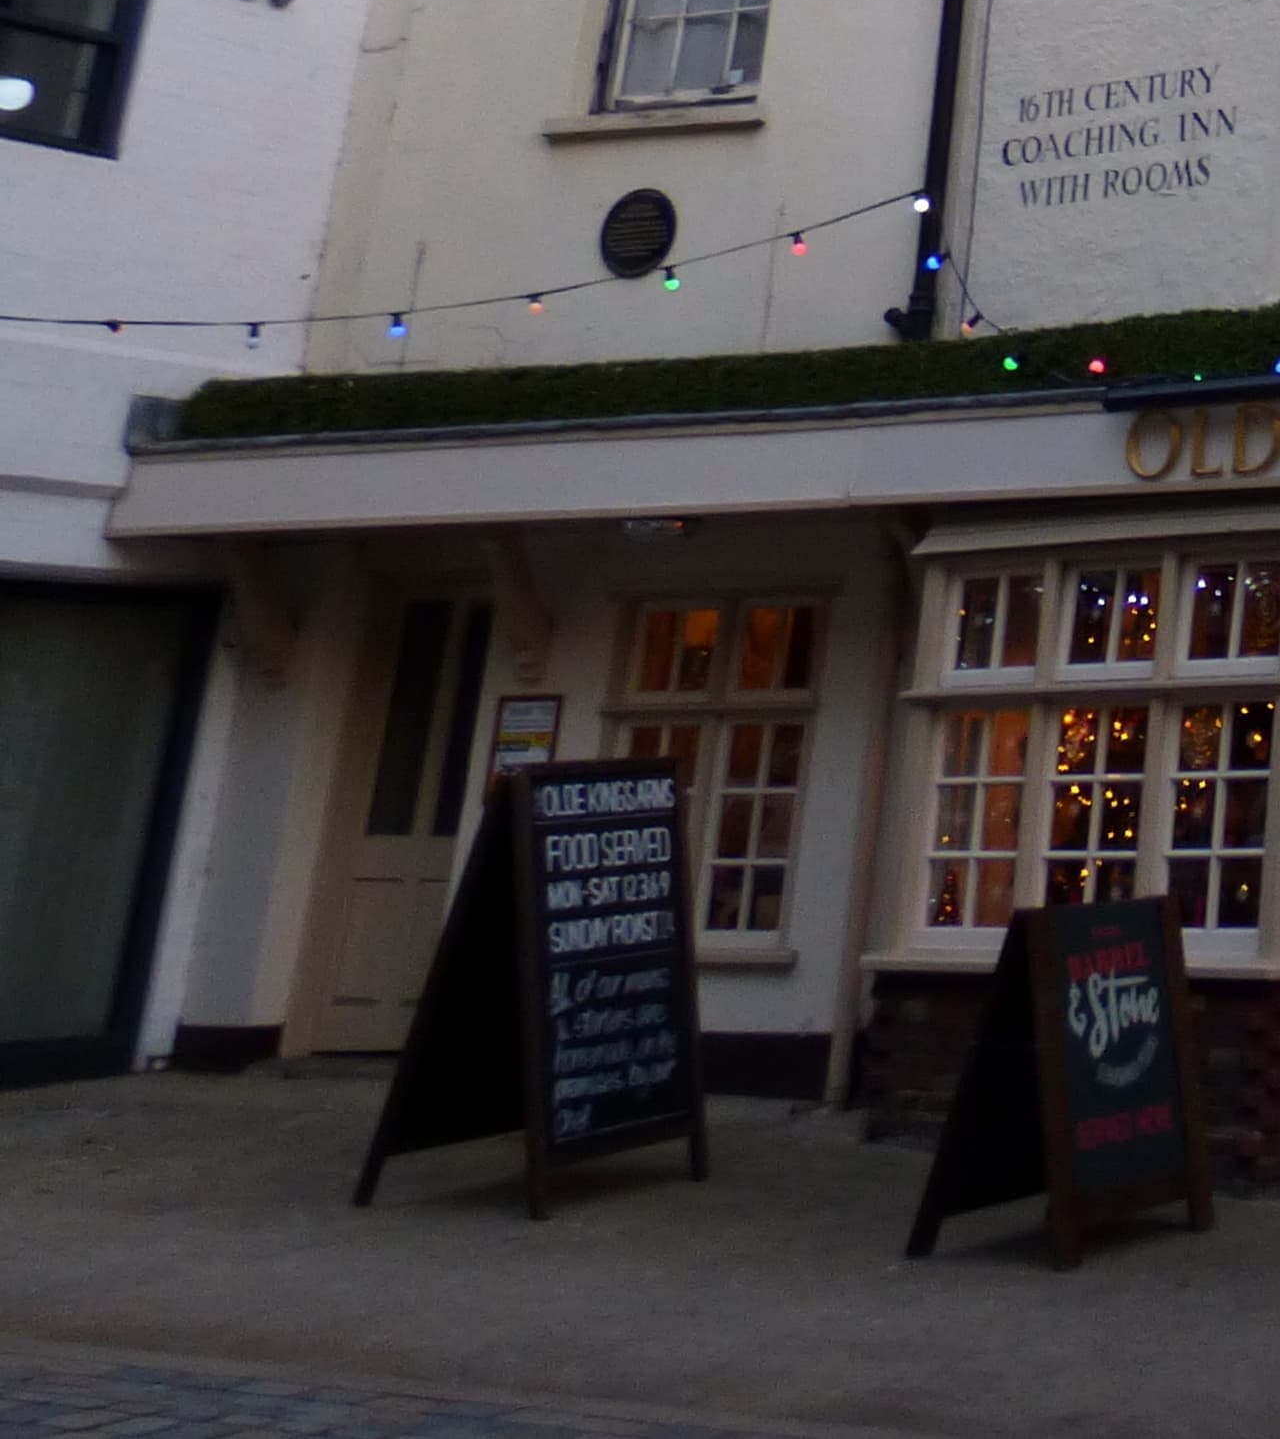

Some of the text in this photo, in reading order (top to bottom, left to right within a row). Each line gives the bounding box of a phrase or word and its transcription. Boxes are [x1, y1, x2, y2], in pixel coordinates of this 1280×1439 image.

[1018, 64, 1220, 123] 16TH CENTURY
[1002, 107, 1237, 166] COACHING INN
[1020, 155, 1212, 207] WITH ROOMS
[543, 784, 586, 817] OLDE
[588, 780, 636, 812] KINGS
[637, 778, 675, 809] ARMS
[546, 826, 672, 872] FOOD SERVED
[549, 916, 609, 953] SUNDAY
[1088, 968, 1160, 1059] Stone
